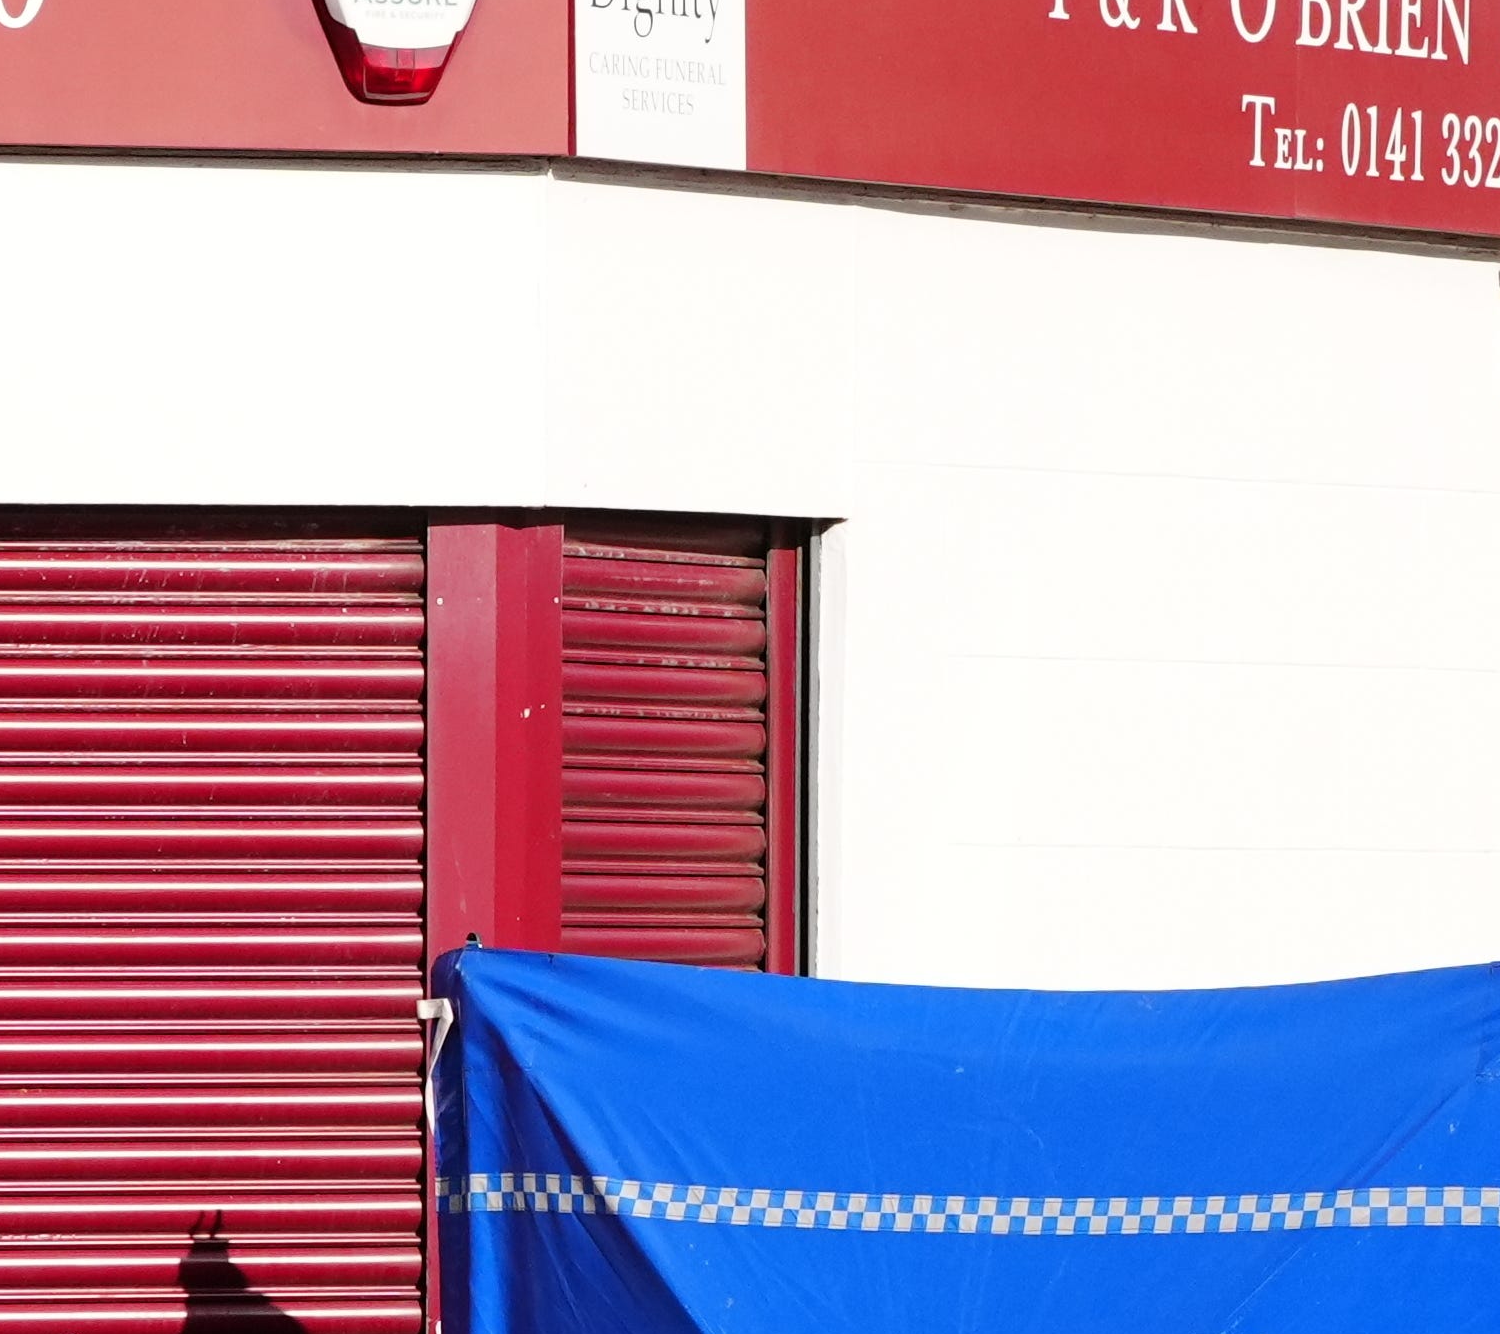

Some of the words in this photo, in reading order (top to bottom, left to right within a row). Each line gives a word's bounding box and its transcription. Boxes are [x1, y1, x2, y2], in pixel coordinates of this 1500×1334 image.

[588, 51, 650, 79] CARING
[655, 58, 727, 85] FUNERAL
[621, 88, 694, 115] SERVICES
[1341, 102, 1425, 181] 0141
